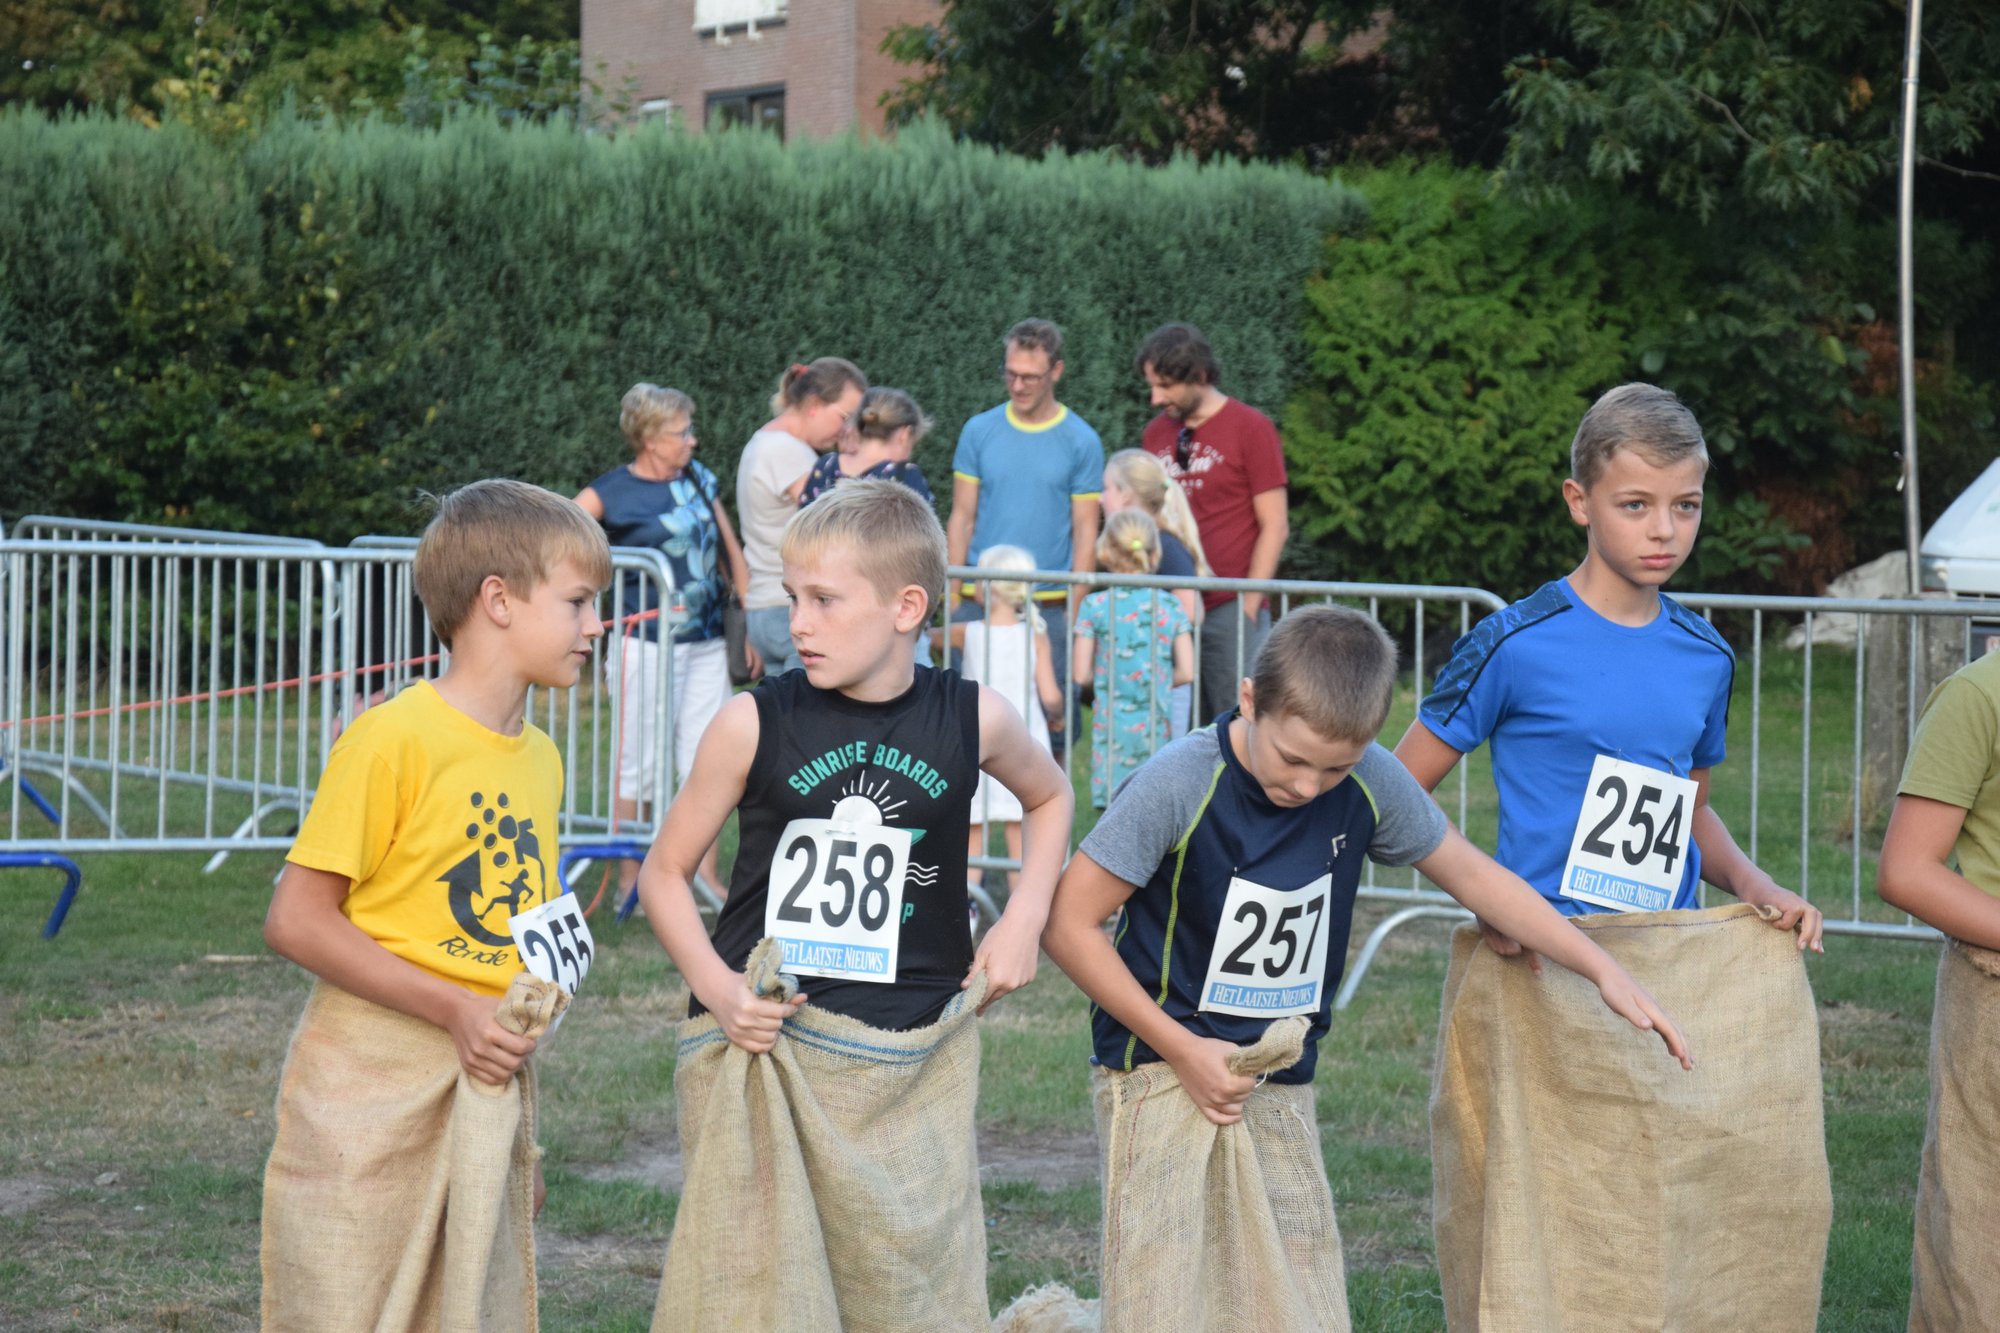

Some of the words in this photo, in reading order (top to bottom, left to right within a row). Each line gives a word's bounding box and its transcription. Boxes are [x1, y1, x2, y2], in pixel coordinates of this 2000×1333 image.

[788, 741, 867, 796] SUNRISE
[872, 744, 948, 799] BOARDS
[1581, 775, 1684, 874] 254
[776, 835, 894, 932] 258
[1574, 869, 1597, 891] HET
[1595, 874, 1637, 902] LAATSTE
[1635, 884, 1667, 910] NIEUWS
[437, 935, 509, 966] Ronde
[523, 912, 592, 996] 255
[798, 942, 843, 968] LAATSTE
[843, 946, 884, 972] NIEUWS
[1220, 893, 1325, 978] 257
[1213, 984, 1237, 1003] HET
[1236, 987, 1280, 1007] LAATSTE
[1279, 986, 1313, 1006] NIEUWS
